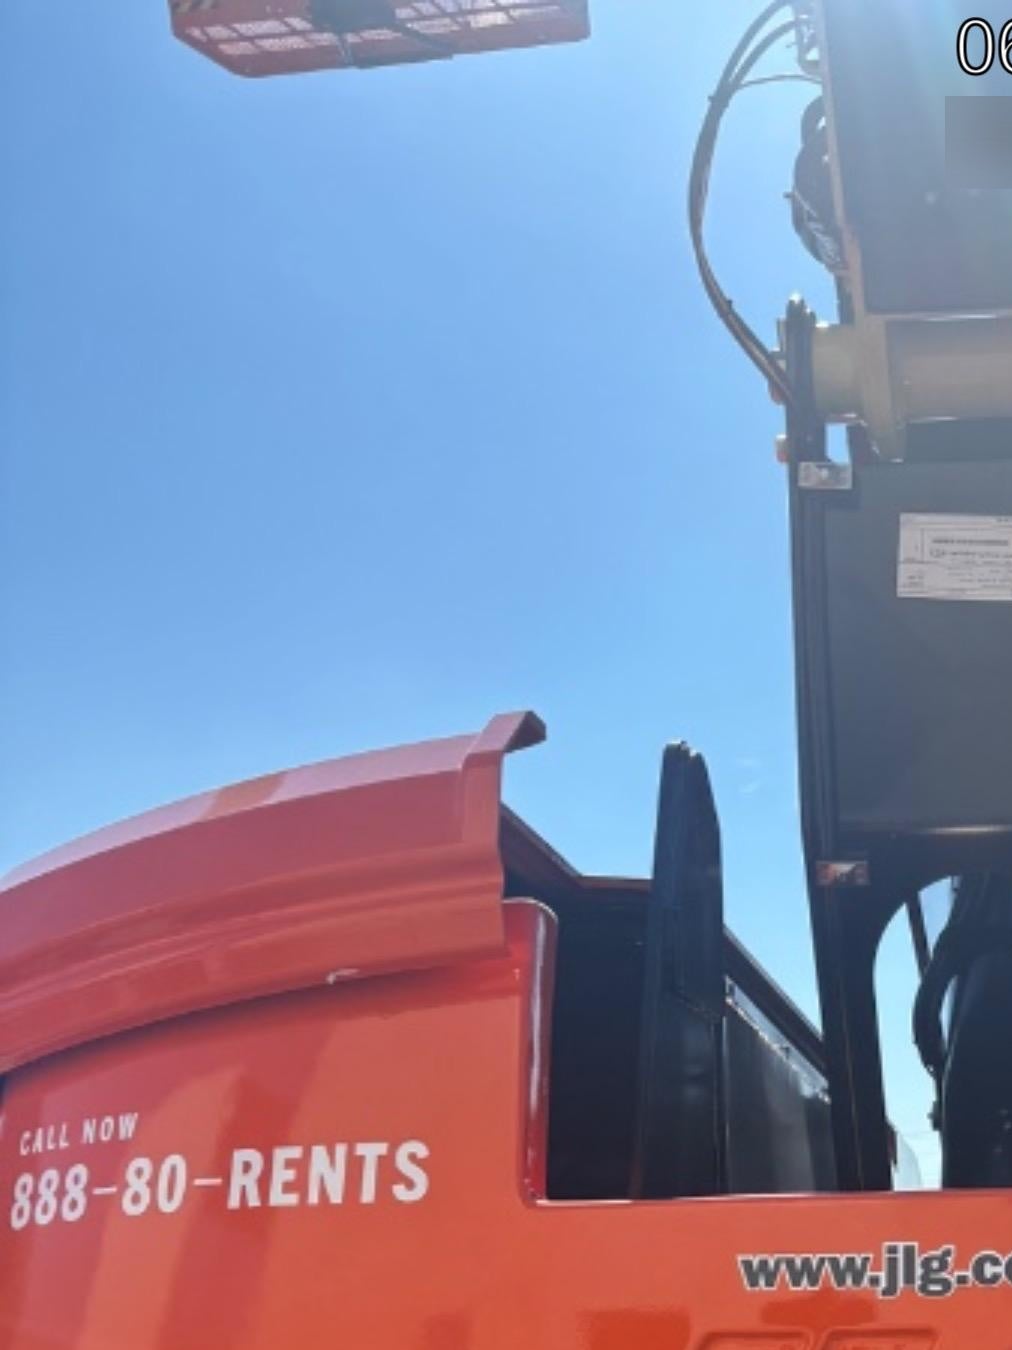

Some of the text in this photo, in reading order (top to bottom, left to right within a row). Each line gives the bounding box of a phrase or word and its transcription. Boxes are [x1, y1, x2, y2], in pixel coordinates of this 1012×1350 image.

[19, 1112, 139, 1156] CALL NOW
[10, 1140, 430, 1231] 888-80-RENTS
